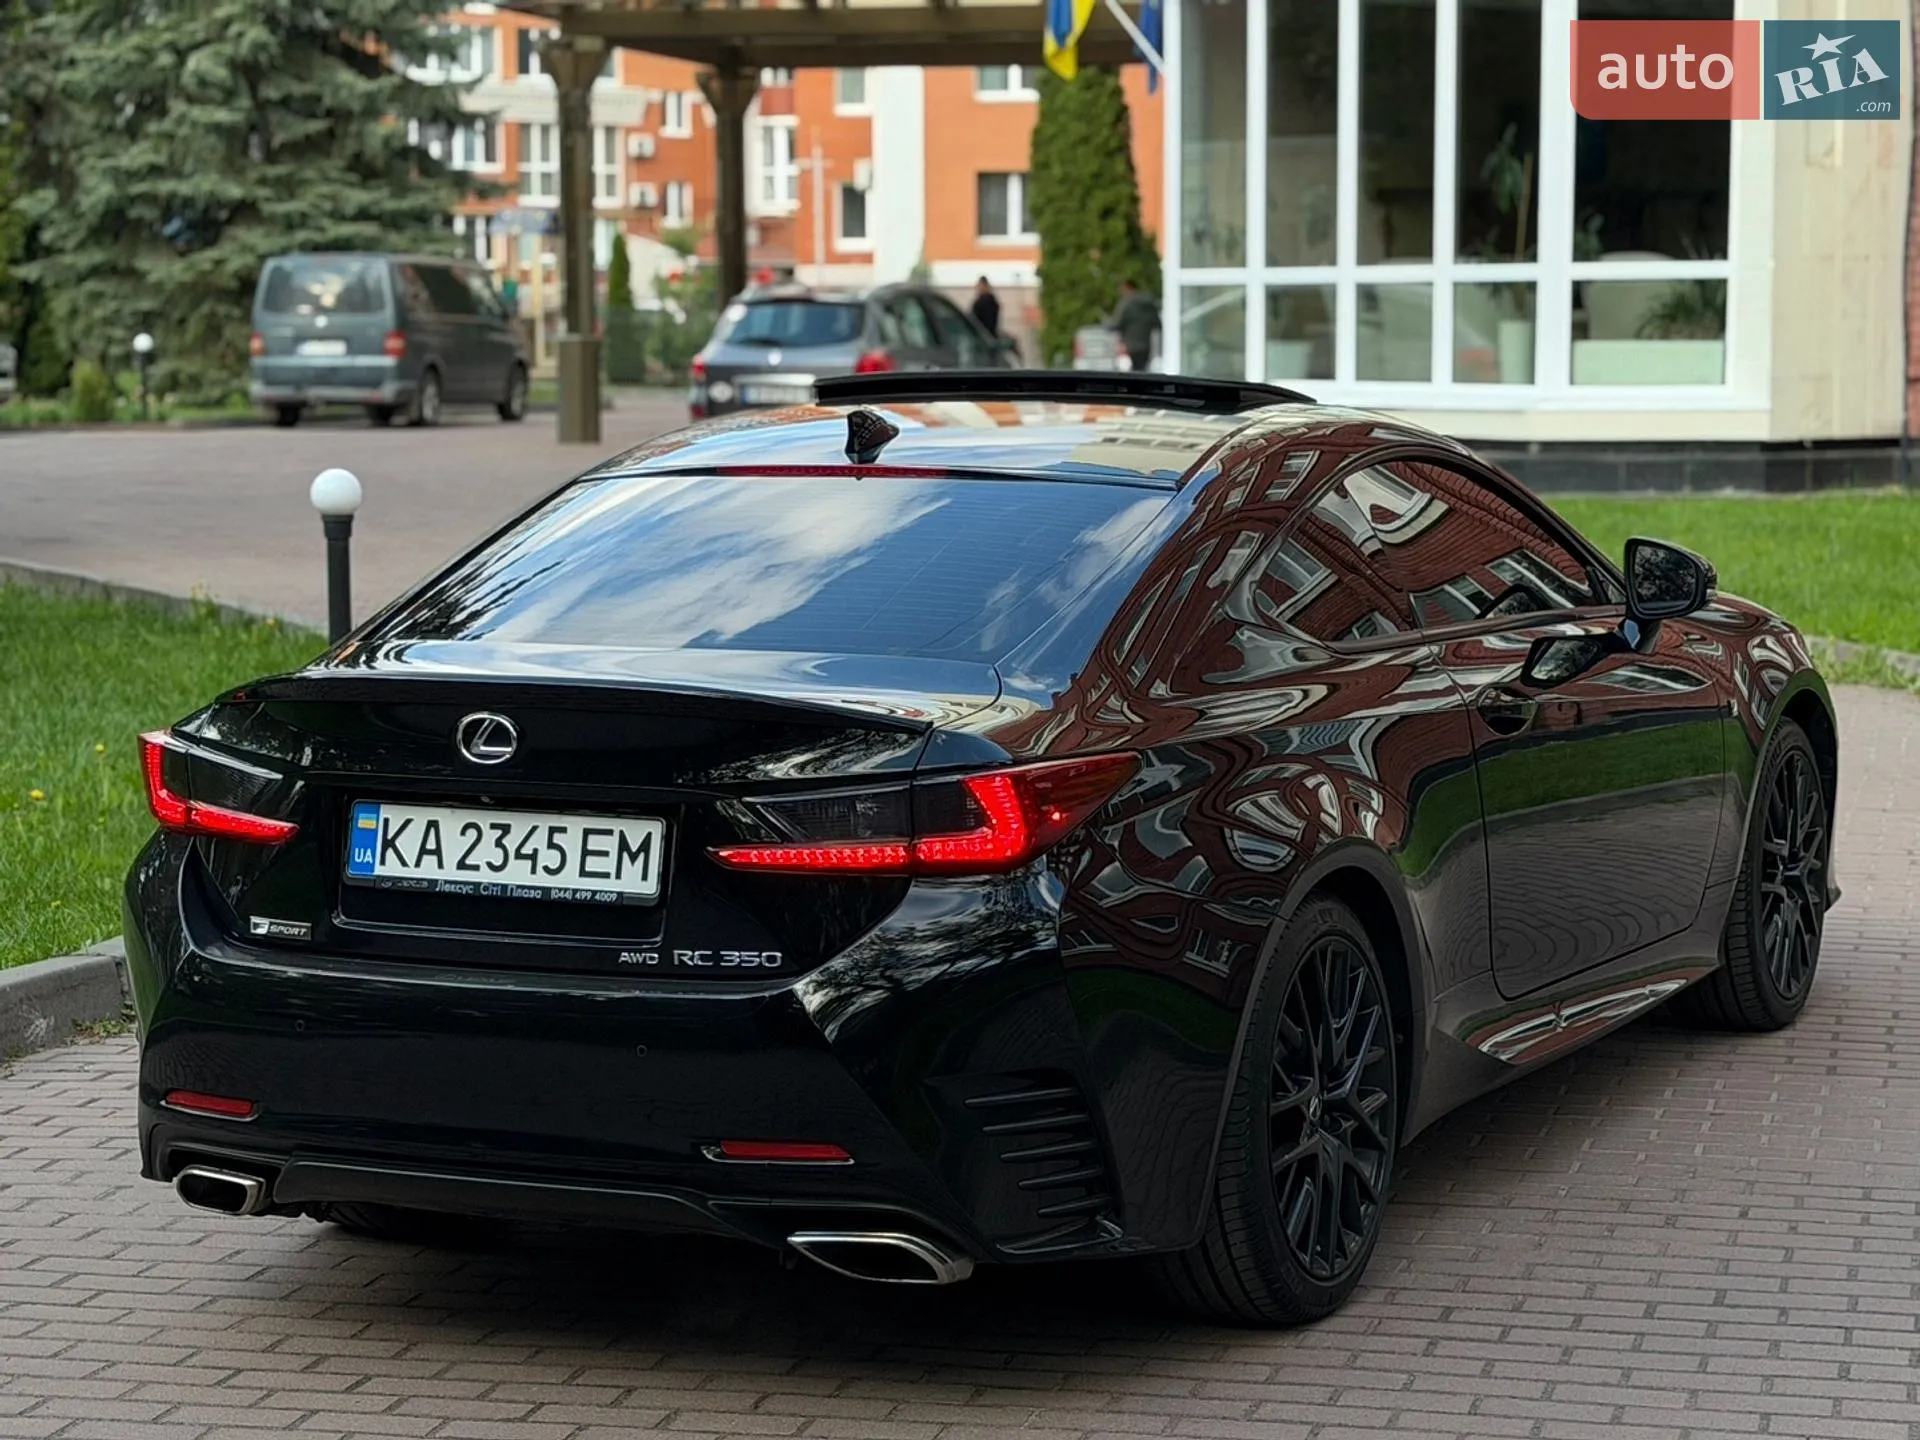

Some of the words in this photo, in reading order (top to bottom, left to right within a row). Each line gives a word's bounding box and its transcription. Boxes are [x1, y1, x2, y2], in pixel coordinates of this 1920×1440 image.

[354, 847, 374, 865] UA
[455, 821, 568, 877] 2345
[269, 924, 308, 936] SPORT
[618, 951, 660, 965] AWD
[672, 949, 714, 966] RC
[719, 950, 783, 968] 350
